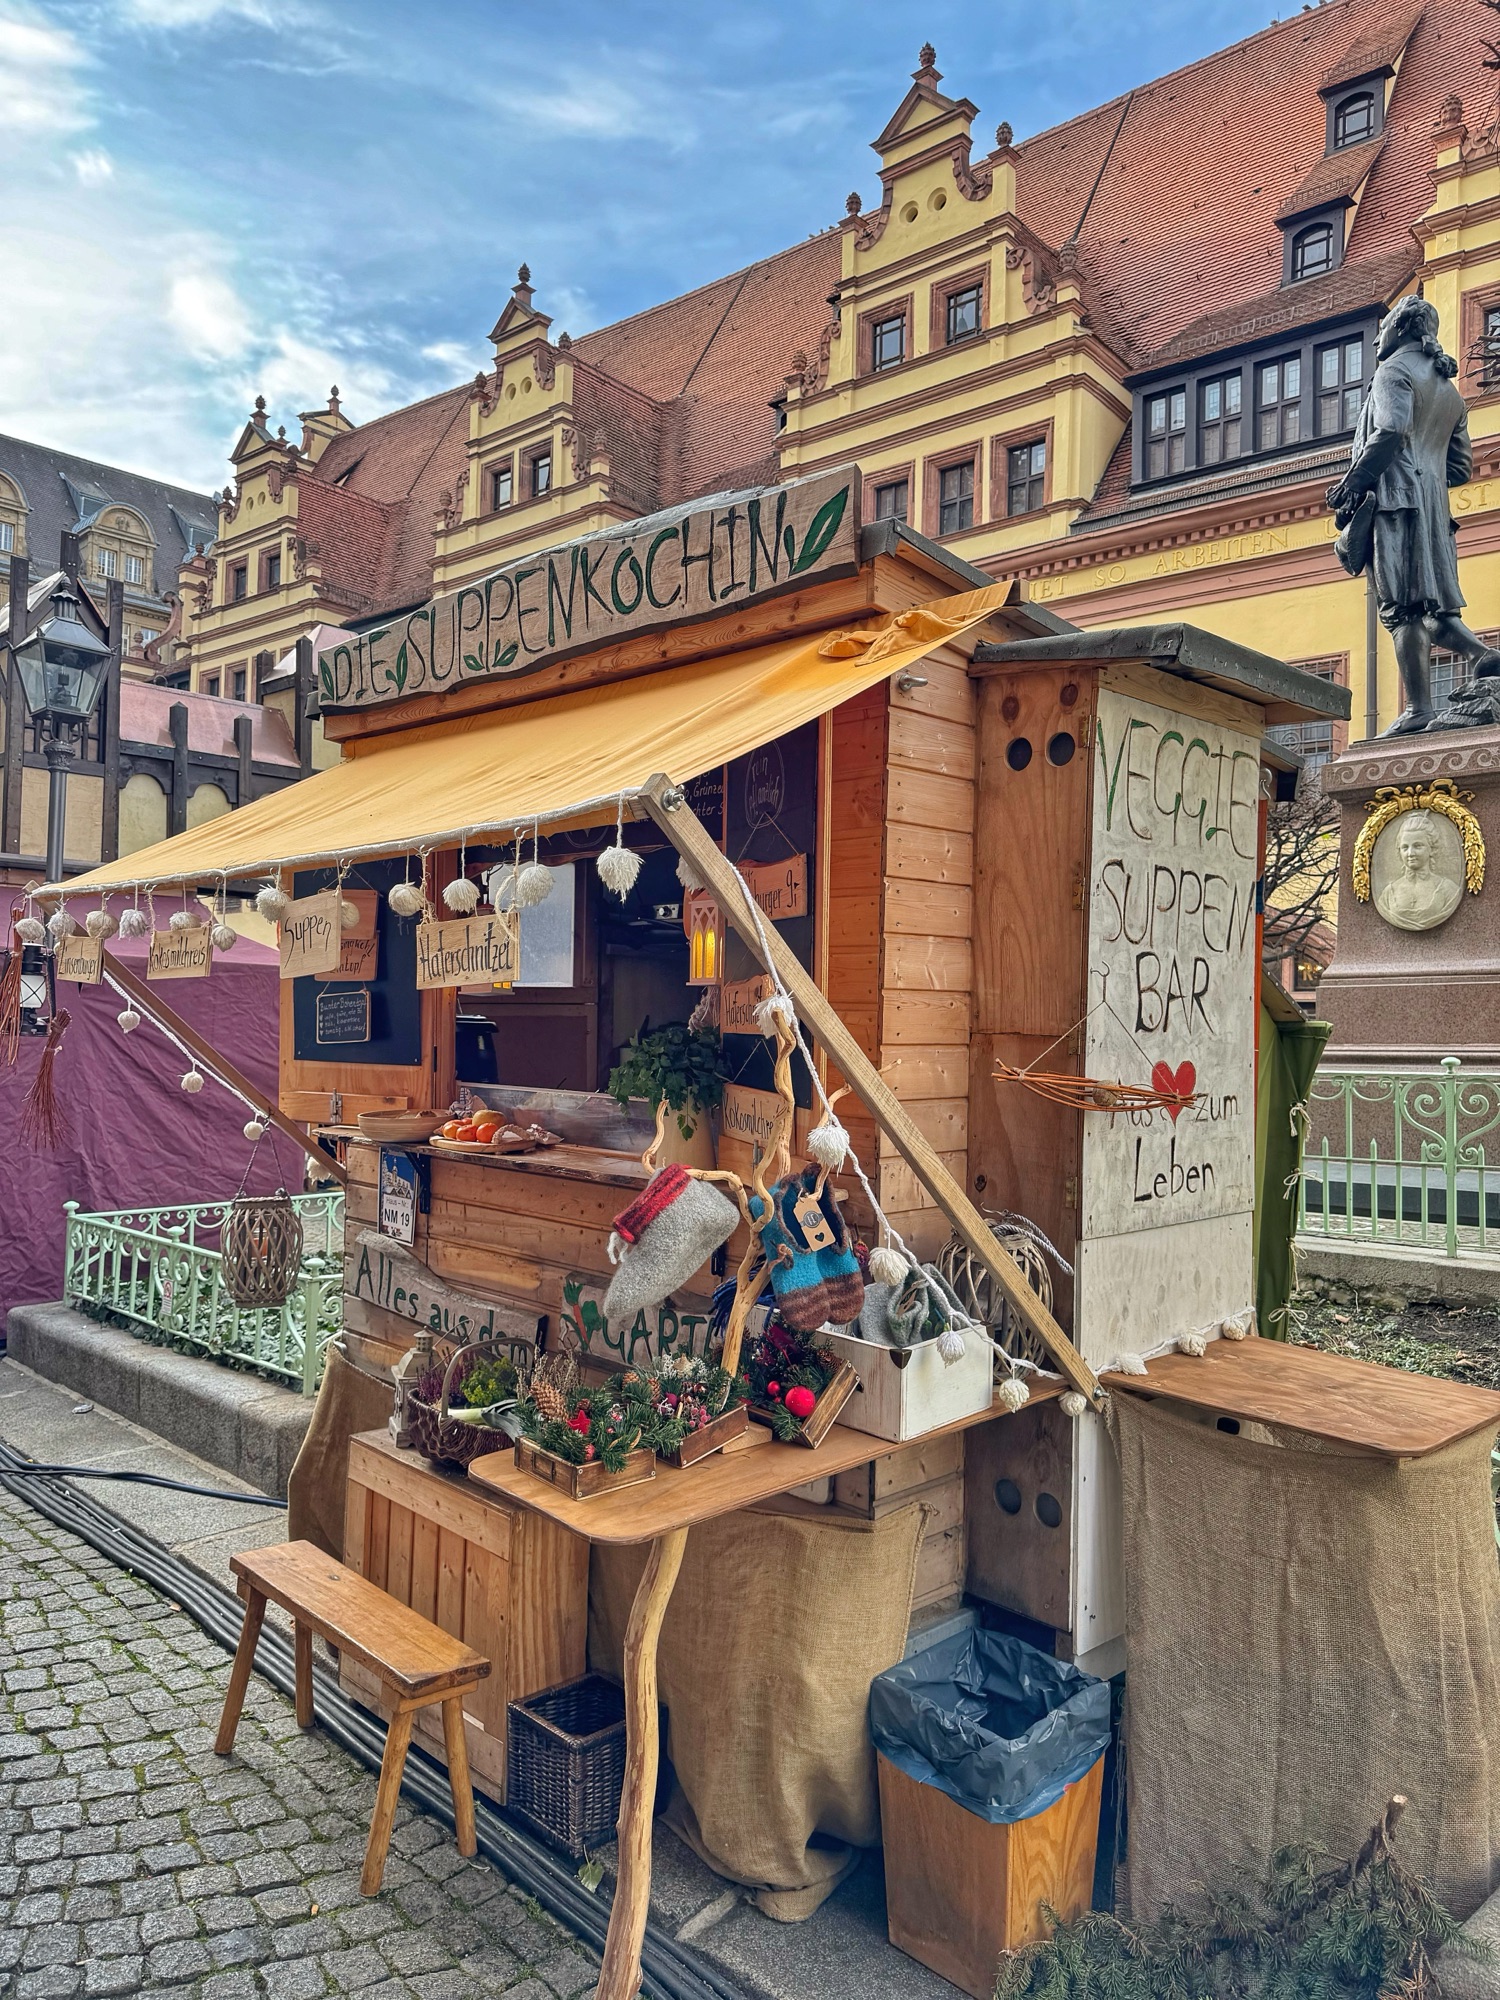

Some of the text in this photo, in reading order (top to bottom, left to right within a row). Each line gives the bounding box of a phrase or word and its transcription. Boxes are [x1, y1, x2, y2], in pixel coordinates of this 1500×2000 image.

[1094, 564, 1126, 587] SO
[1152, 527, 1290, 575] ARBEITEN
[334, 491, 788, 703] DIE SUPPENKÖCHIN
[1097, 717, 1259, 860] VEGGIE
[284, 915, 332, 969] Suppen
[1102, 858, 1256, 954] SUPPEN
[419, 922, 513, 983] Haferschnitzel
[1134, 951, 1215, 1035] BAR
[1134, 1134, 1216, 1203] Leben
[384, 1208, 410, 1227] NM 19
[355, 1244, 419, 1319] Alles
[430, 1303, 470, 1346] aus
